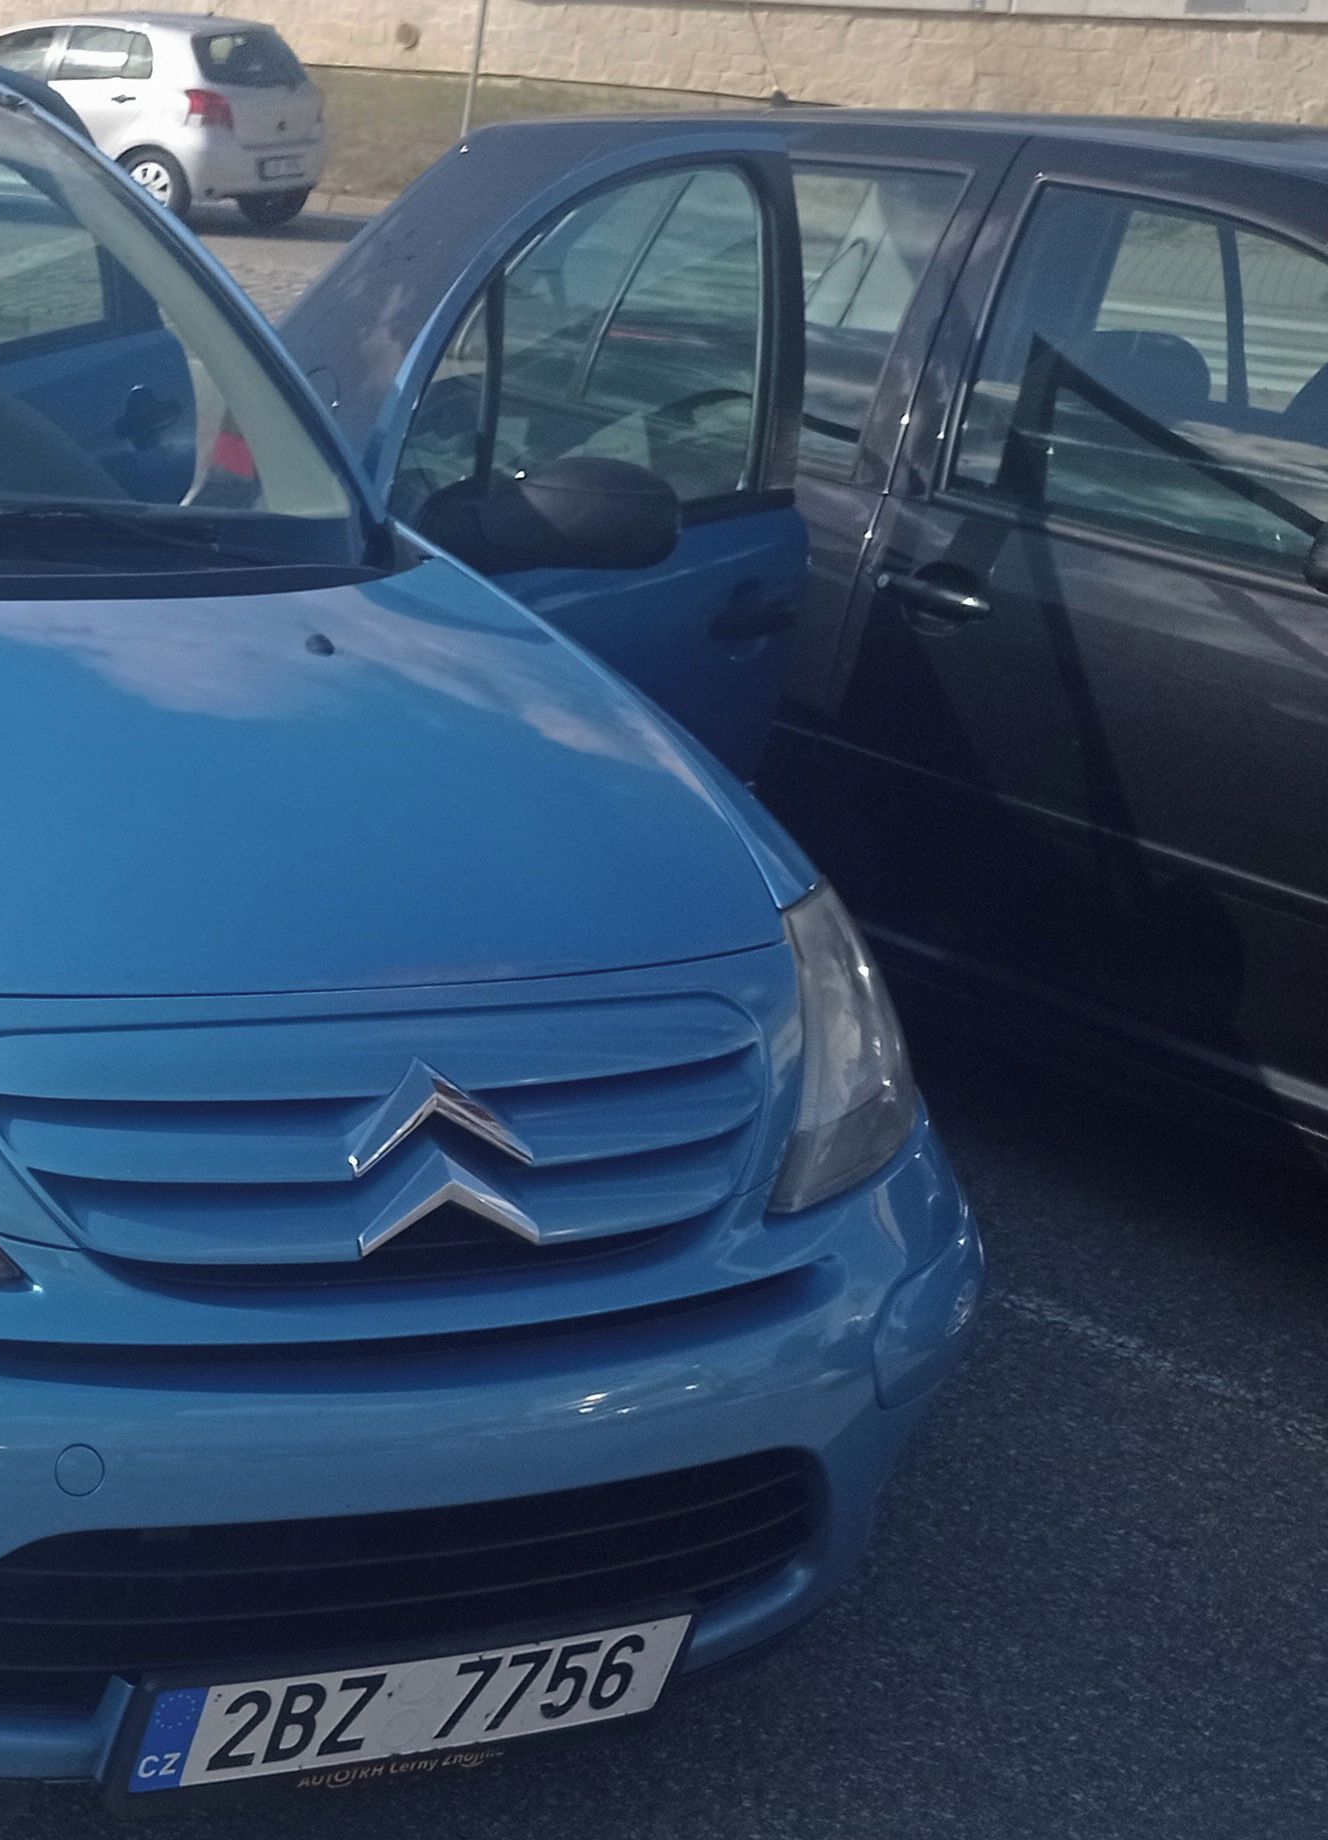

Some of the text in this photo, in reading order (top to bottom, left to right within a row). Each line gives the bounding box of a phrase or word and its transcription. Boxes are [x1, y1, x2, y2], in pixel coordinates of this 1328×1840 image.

[205, 1633, 646, 1772] 2BZ 7756
[138, 1753, 181, 1779] CZ
